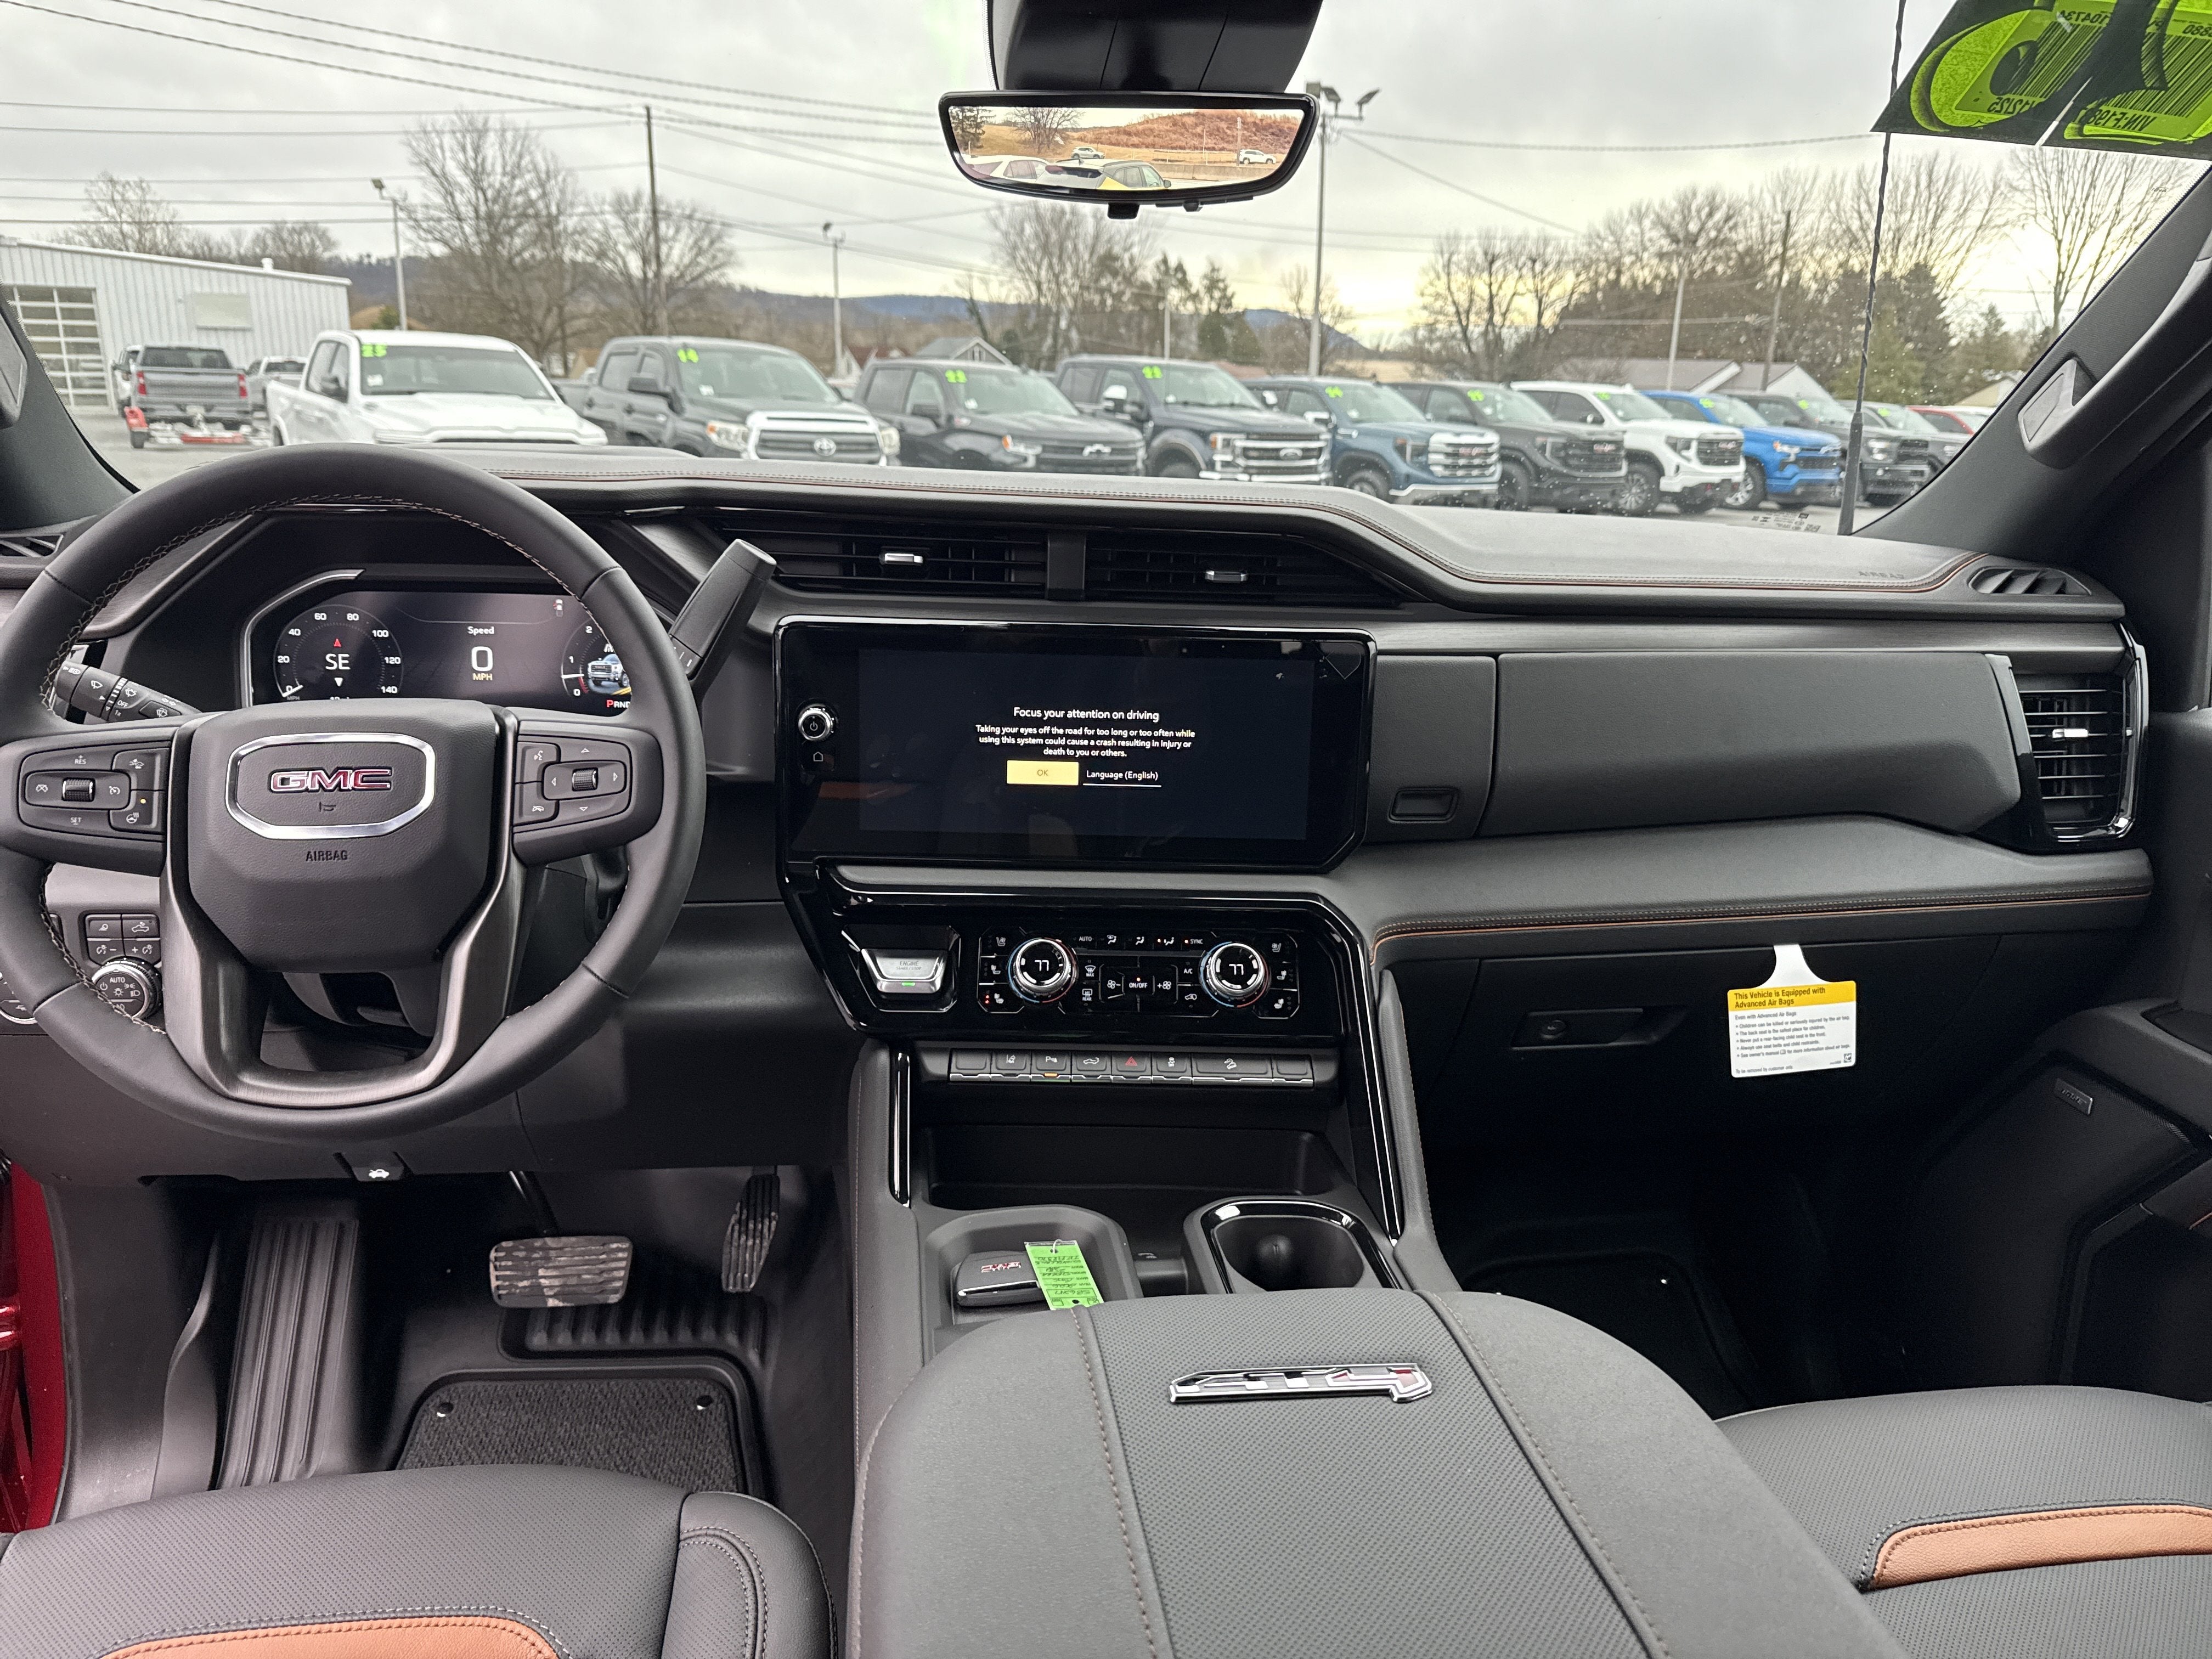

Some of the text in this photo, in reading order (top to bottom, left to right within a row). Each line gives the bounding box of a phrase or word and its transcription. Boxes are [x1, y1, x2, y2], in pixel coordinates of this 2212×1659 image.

[467, 626, 494, 636] Speed
[585, 625, 592, 634] 2
[325, 653, 351, 670] SE
[471, 646, 493, 672] 0
[117, 699, 129, 708] OFF
[1013, 707, 1042, 717] Focus
[1043, 710, 1065, 720] your
[1066, 709, 1110, 719] attention
[1126, 710, 1159, 723] driving
[975, 725, 1000, 735] Taking
[1065, 726, 1082, 735] road
[1084, 727, 1095, 735] for
[1111, 728, 1128, 738] long
[1153, 729, 1174, 737] often
[1175, 729, 1195, 737] while
[979, 736, 1000, 745] using
[1017, 737, 1043, 746] system
[1045, 737, 1065, 745] could
[1096, 738, 1116, 746] crash
[1118, 739, 1150, 749] resulting
[1160, 740, 1182, 749] injury
[1043, 747, 1065, 755] death
[1066, 748, 1074, 756] to
[1100, 748, 1127, 757] others.
[270, 767, 392, 793] GMC
[1086, 770, 1158, 781] Language (English)
[306, 850, 348, 862] AIRBAG
[1035, 960, 1049, 971] 77
[1229, 964, 1244, 975] 77
[1750, 990, 1773, 998] Vehicle
[1781, 988, 1810, 997] Equipped
[1735, 1000, 1766, 1008] Advanced
[1779, 998, 1795, 1006] Bags
